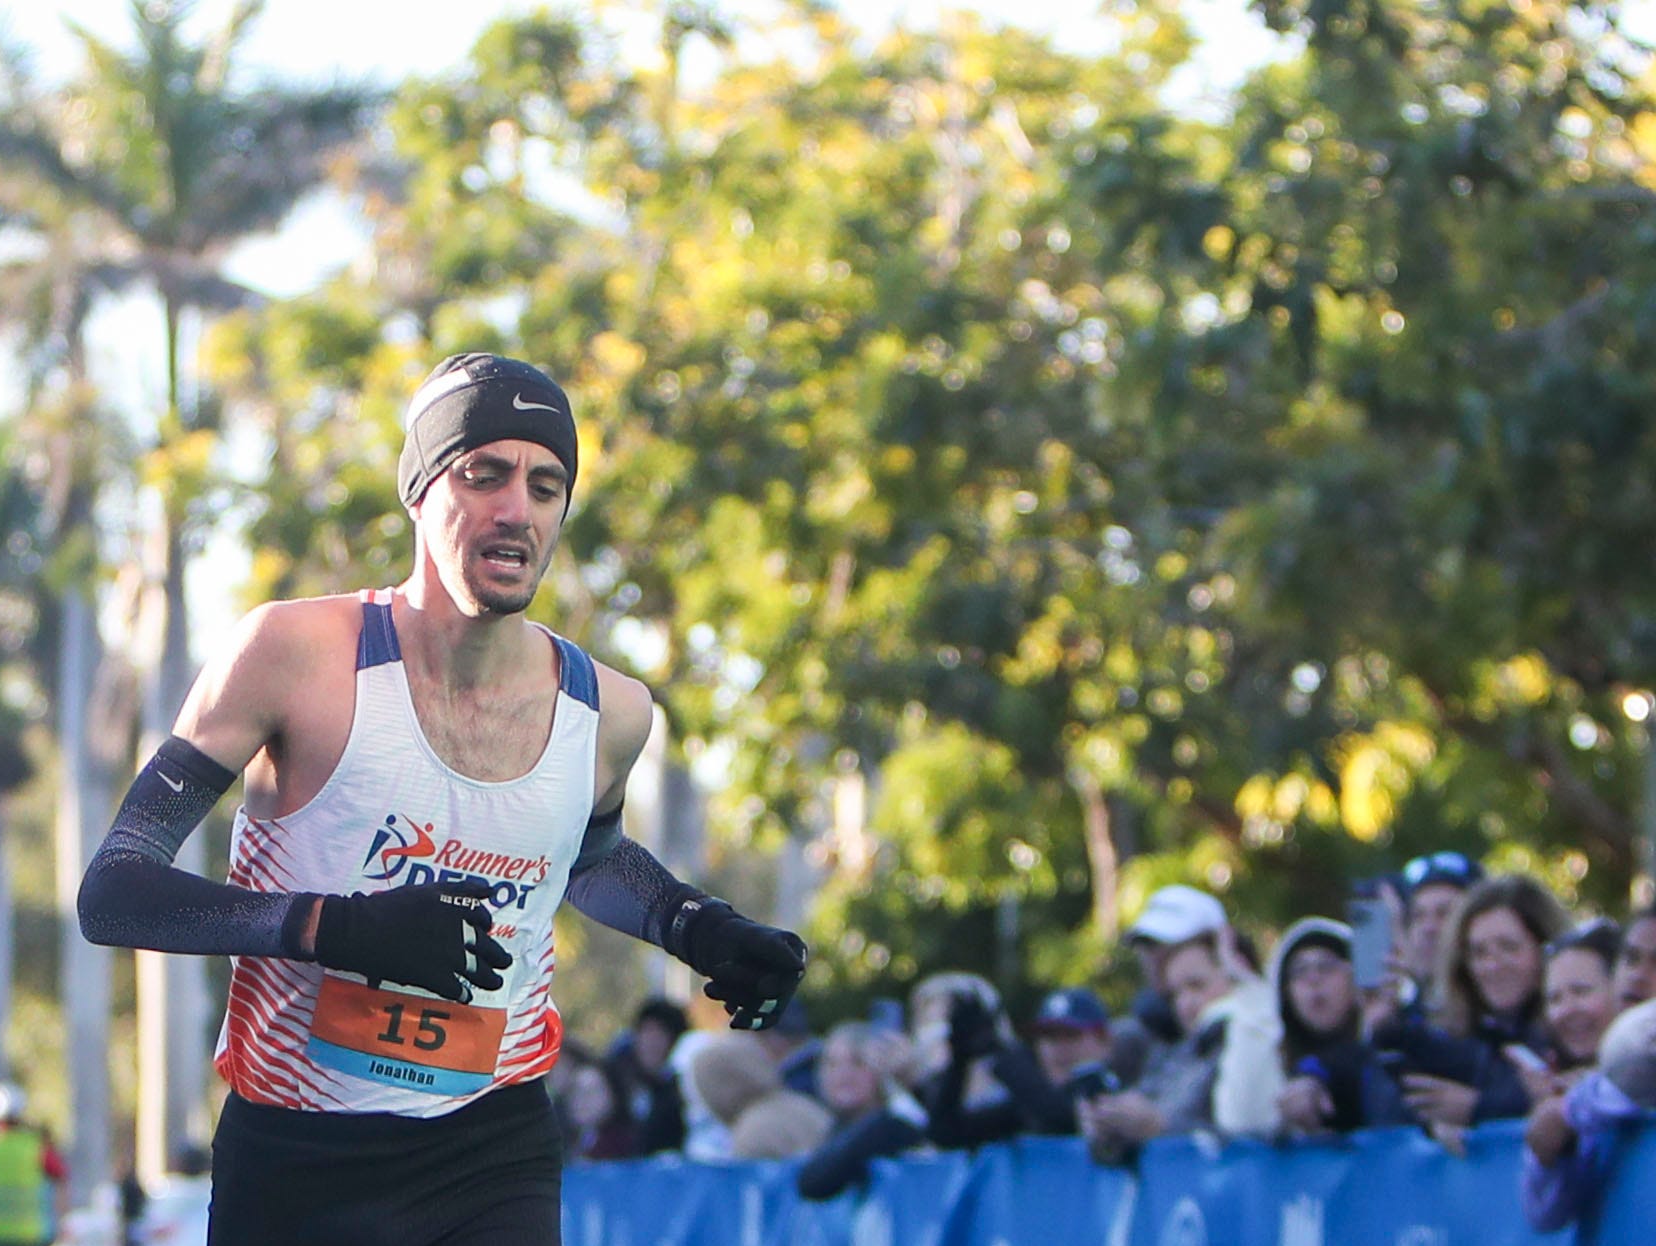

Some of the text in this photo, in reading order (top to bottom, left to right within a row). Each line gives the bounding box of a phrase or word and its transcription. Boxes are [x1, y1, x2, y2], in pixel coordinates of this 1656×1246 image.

[435, 839, 552, 884] Runner's
[378, 1003, 451, 1051] 15
[369, 1060, 435, 1086] Jonathan
